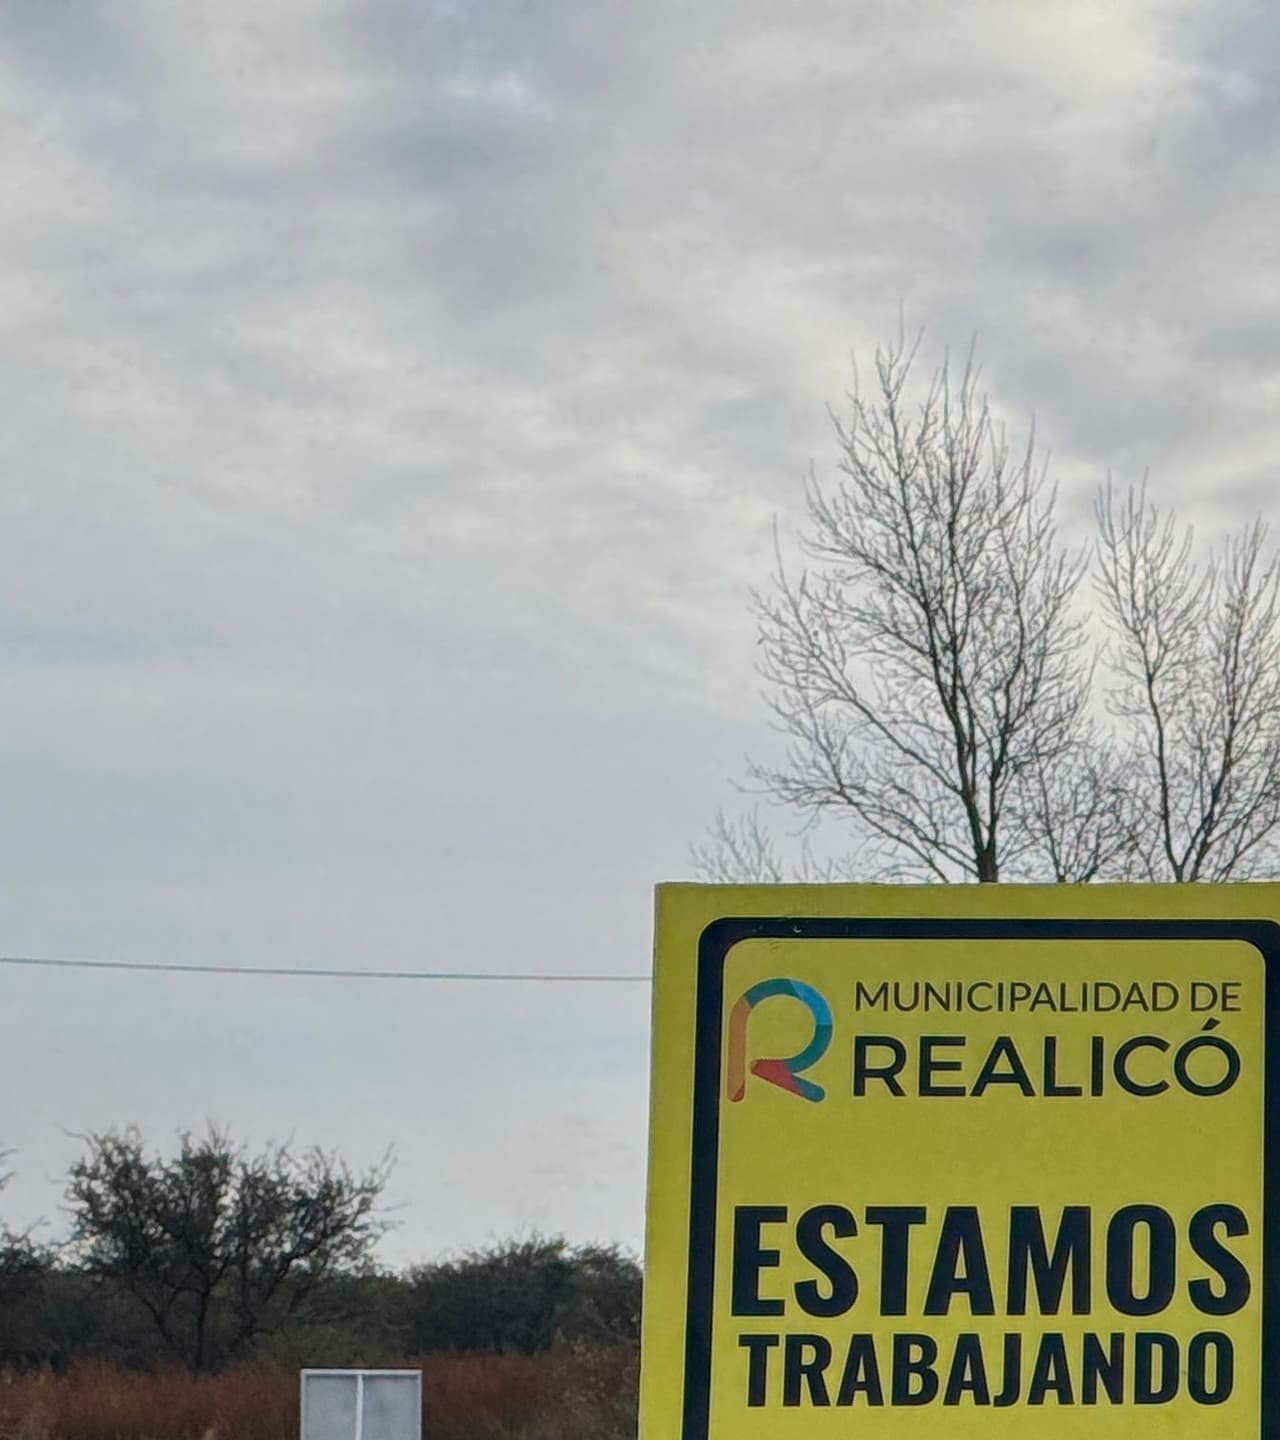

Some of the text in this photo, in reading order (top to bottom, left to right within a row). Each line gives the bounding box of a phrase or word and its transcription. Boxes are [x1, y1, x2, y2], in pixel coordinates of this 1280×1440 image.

[854, 980, 1243, 1013] MUNICIPALIDAD DE
[852, 1017, 1242, 1098] REALICÓ
[730, 1203, 1252, 1318] ESTAMOS
[737, 1331, 1235, 1408] TRABAJANDO
